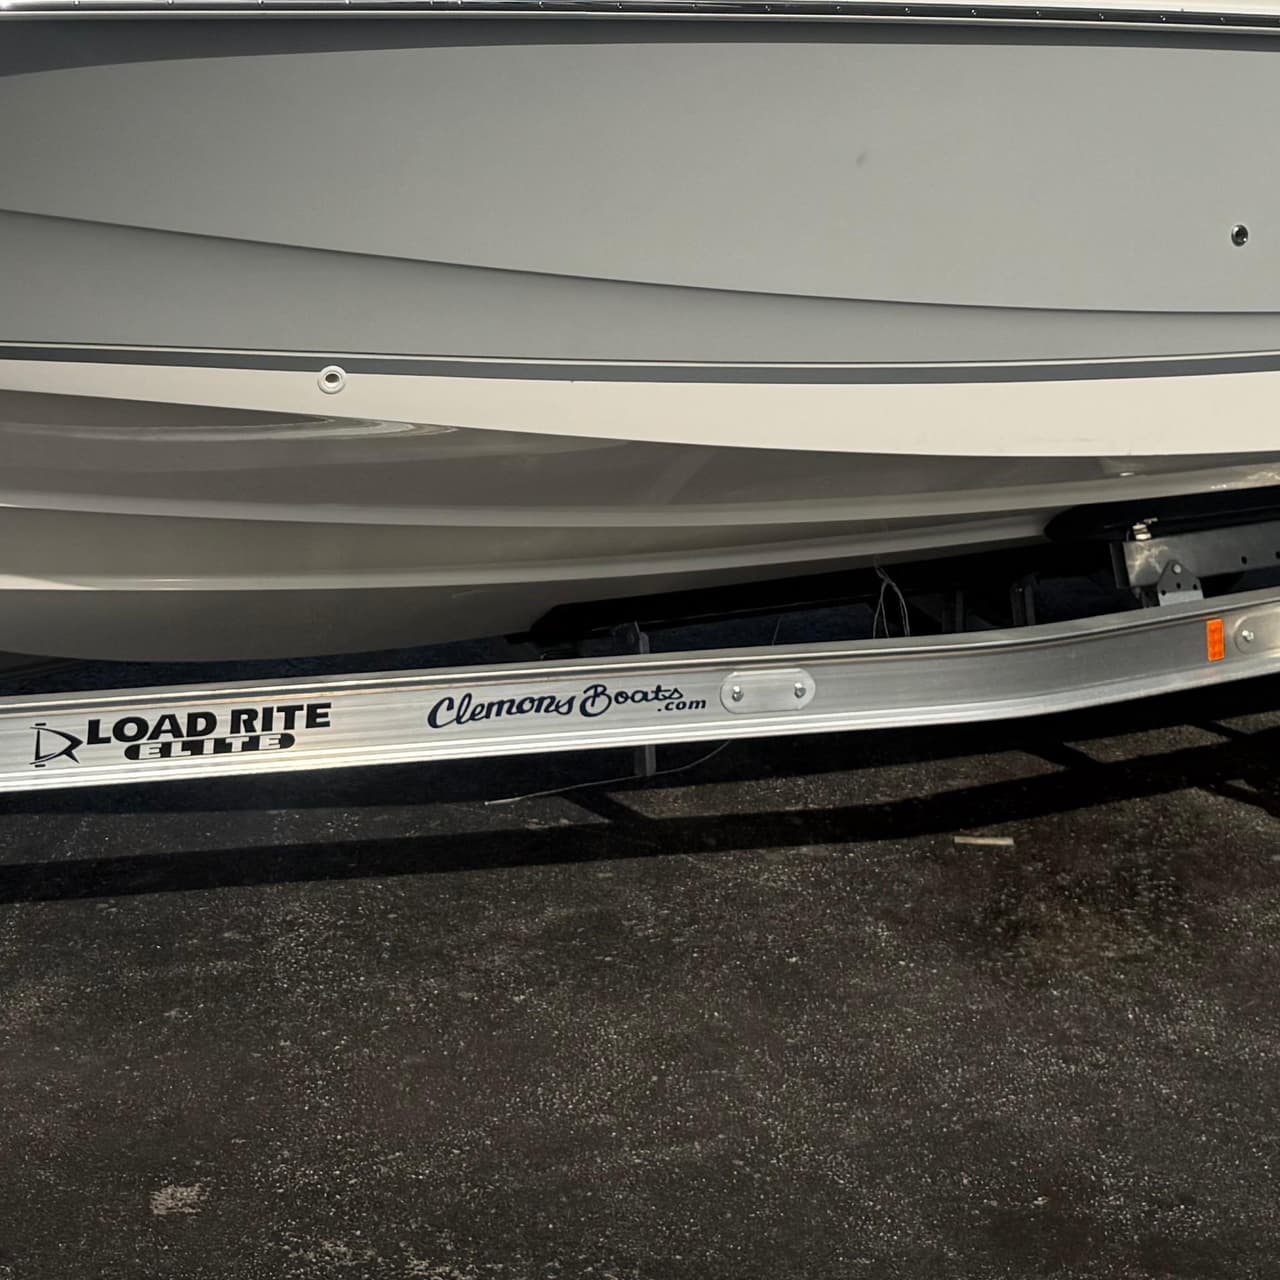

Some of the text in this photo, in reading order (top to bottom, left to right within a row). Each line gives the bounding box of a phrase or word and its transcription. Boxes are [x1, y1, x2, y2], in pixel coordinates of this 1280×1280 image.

[427, 684, 684, 729] Clemons Boats
[657, 698, 707, 712] .com
[87, 702, 332, 745] LOAD RITE
[138, 733, 283, 760] ELITE
